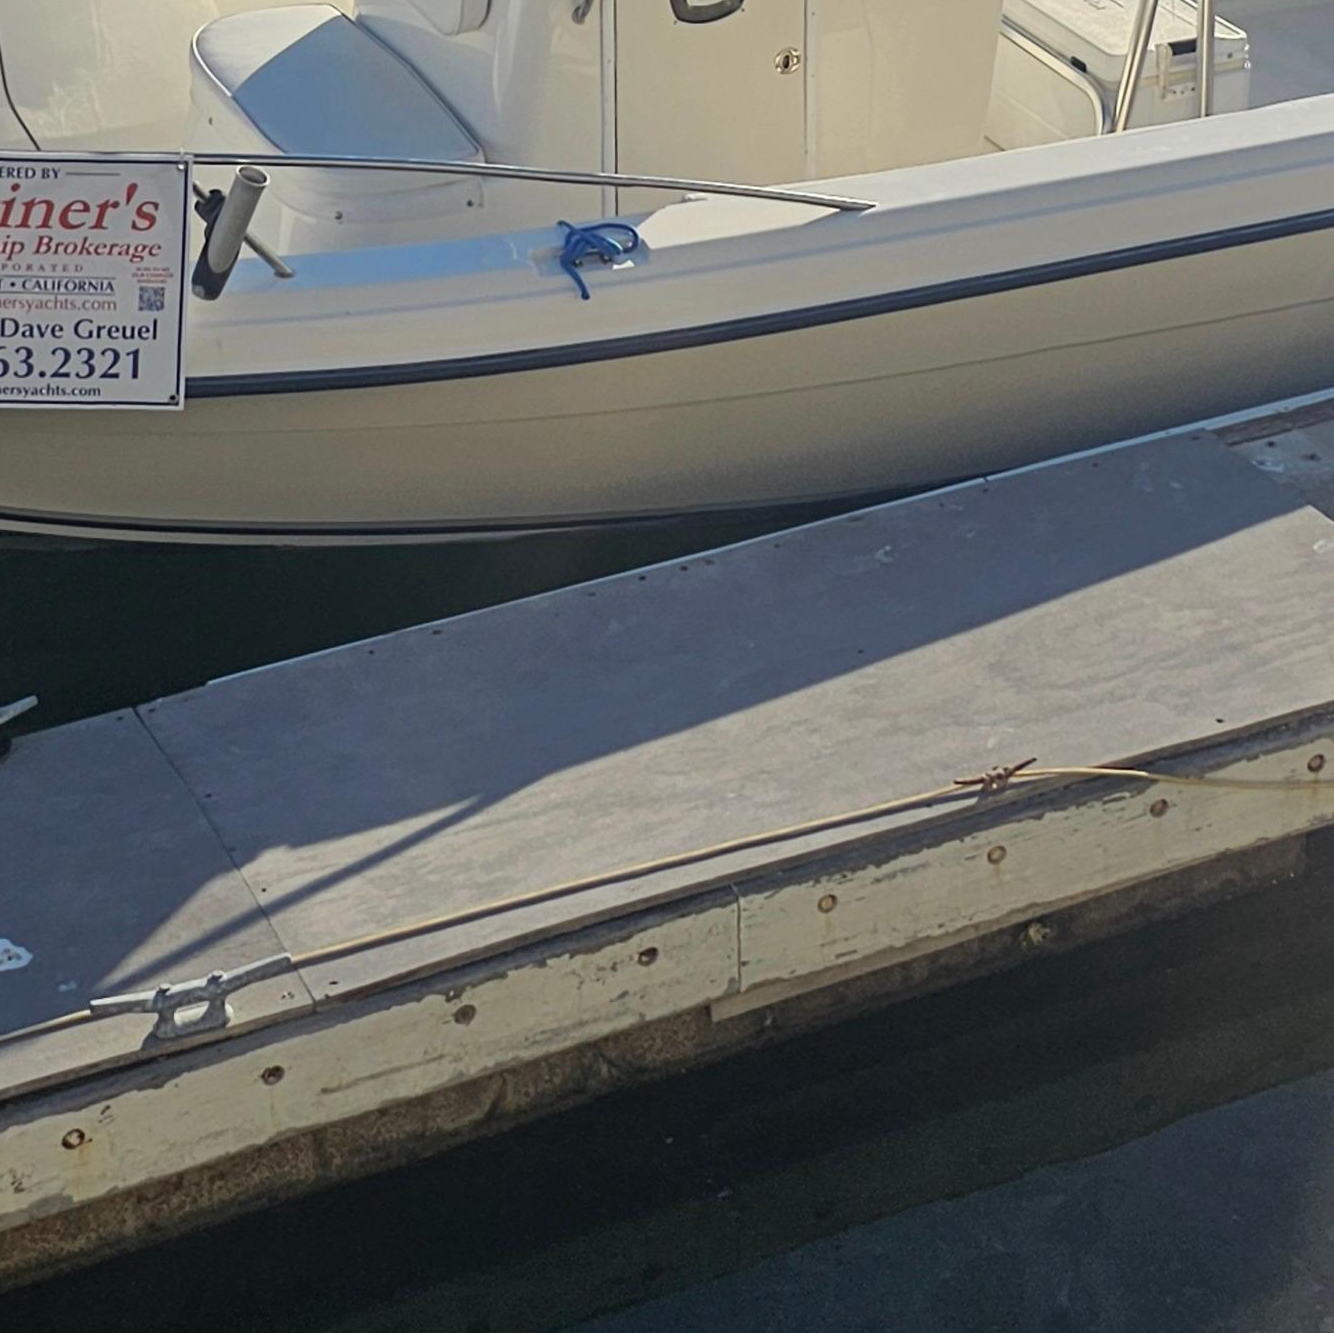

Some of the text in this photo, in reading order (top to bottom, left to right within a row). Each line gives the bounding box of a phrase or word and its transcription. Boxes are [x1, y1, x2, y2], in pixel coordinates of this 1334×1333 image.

[41, 167, 61, 180] BY
[33, 235, 162, 264] Brokerage
[22, 278, 115, 293] CALIFORNIA
[0, 317, 64, 340] Dave
[73, 318, 158, 340] Greuel
